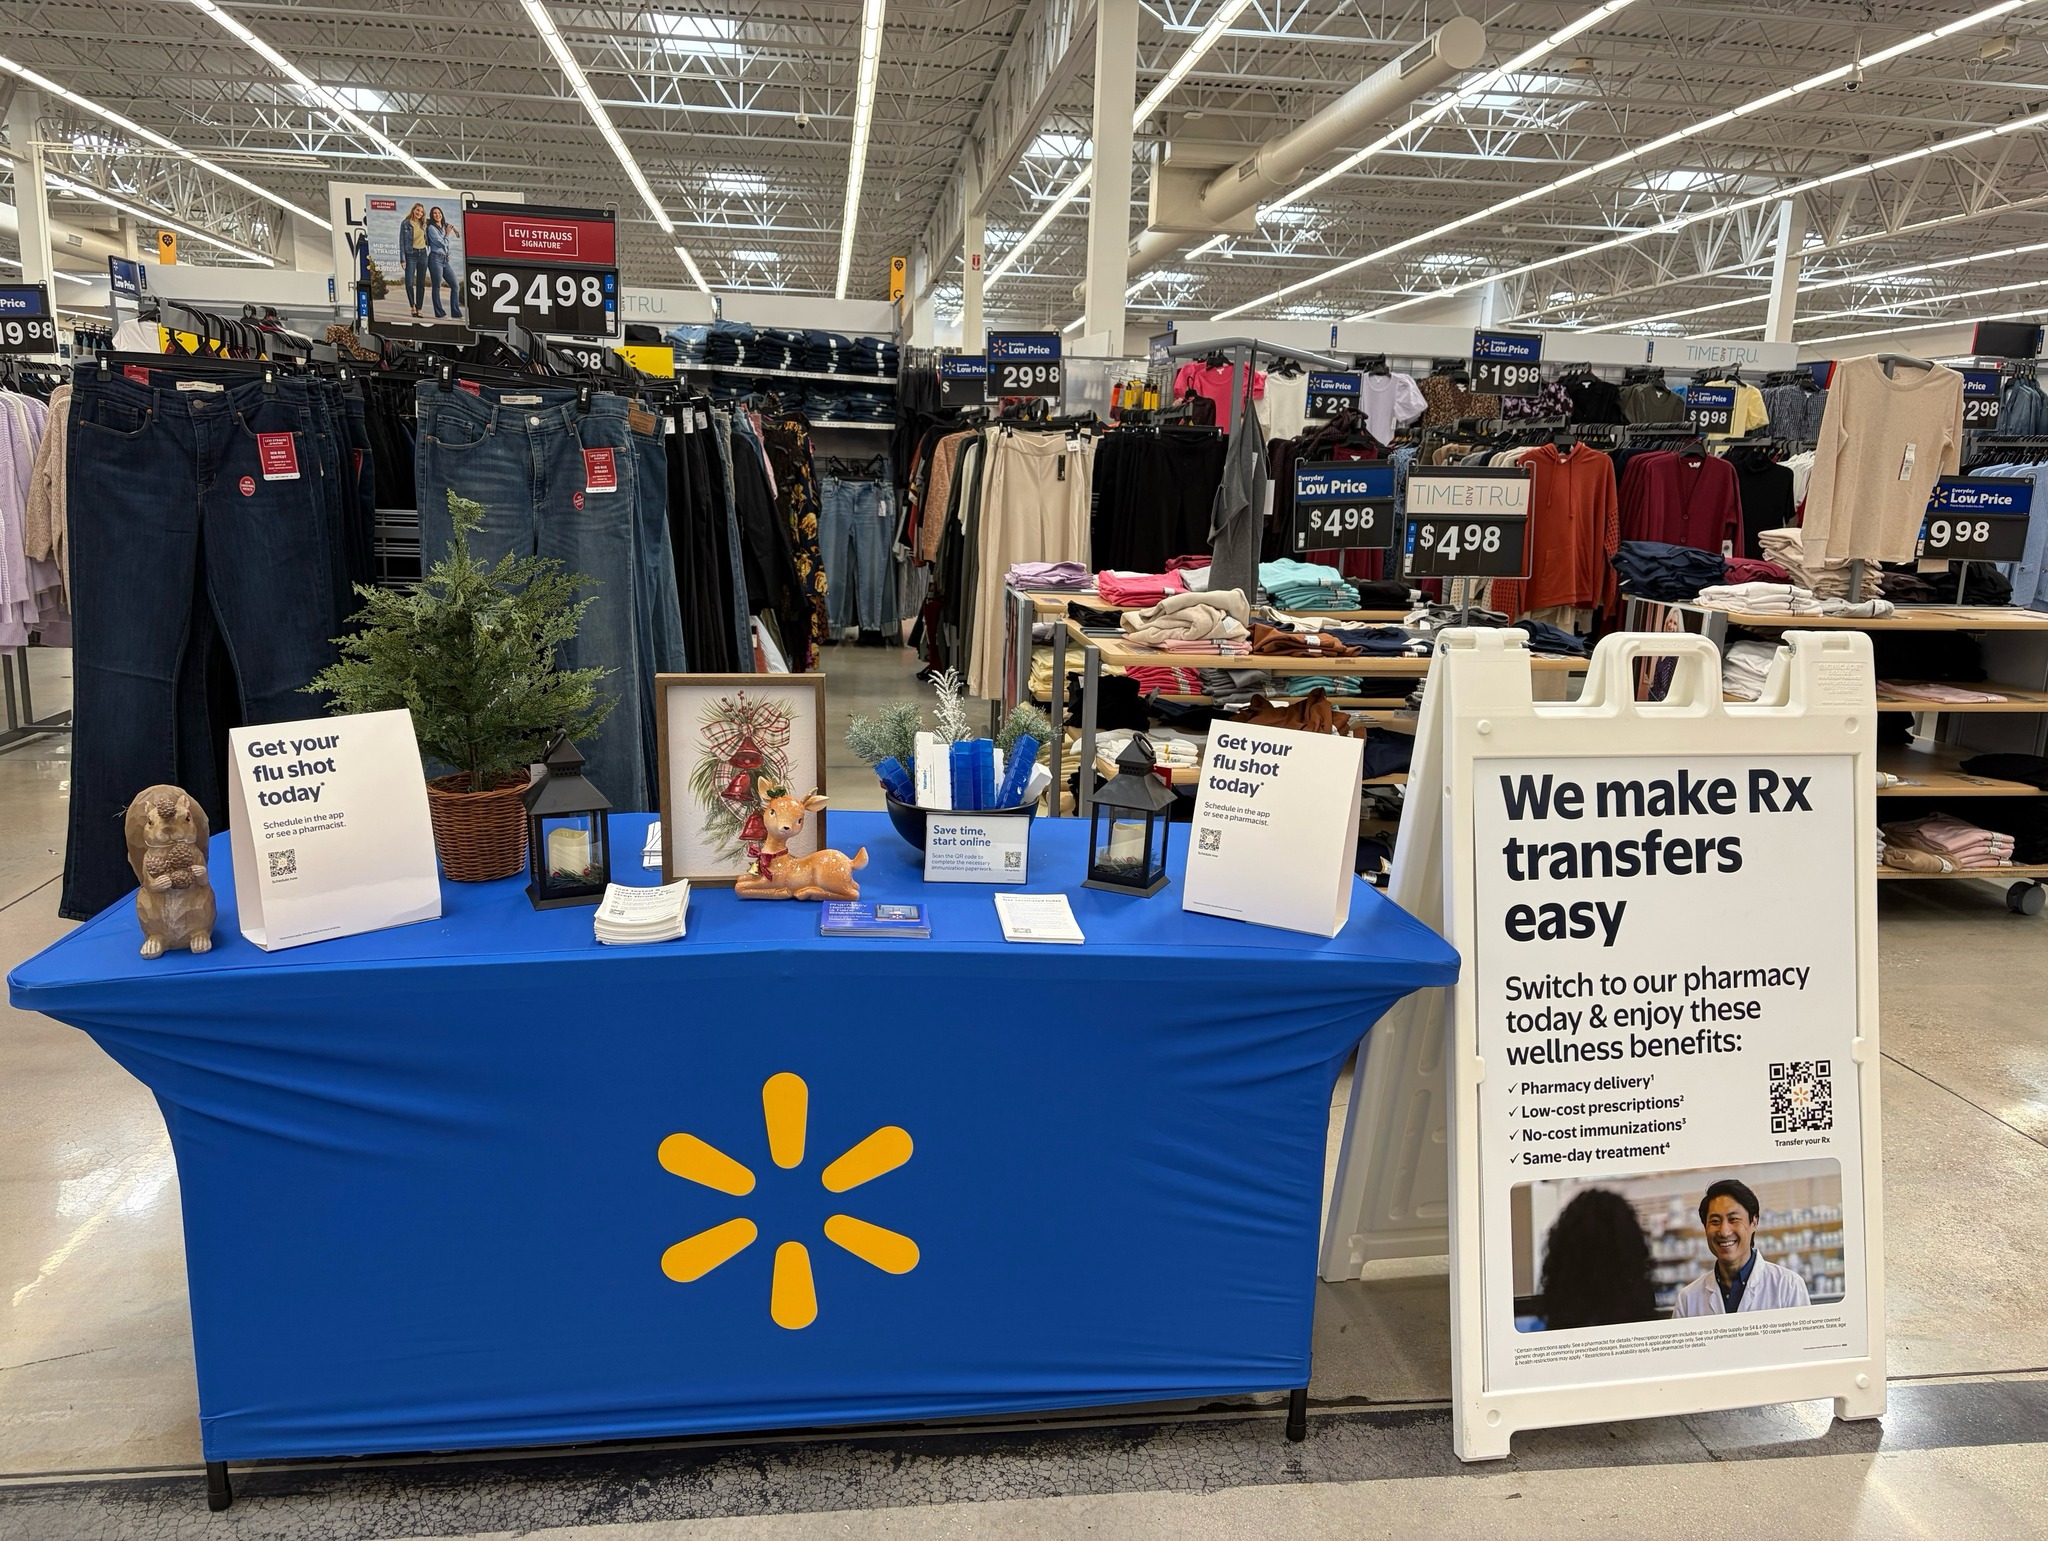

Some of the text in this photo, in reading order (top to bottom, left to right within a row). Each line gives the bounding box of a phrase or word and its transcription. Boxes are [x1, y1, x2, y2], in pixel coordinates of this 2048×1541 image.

[509, 228, 573, 242] LEVI STRAUSS
[469, 269, 603, 315] $2498
[1009, 345, 1050, 354] Low Price
[1490, 343, 1529, 354] Low Price
[1686, 346, 1720, 361] TIME
[1727, 347, 1757, 363] TRU
[957, 365, 971, 373] Low
[972, 365, 987, 373] Pric
[1003, 366, 1059, 388] 2998
[1479, 364, 1539, 387] $1998
[1335, 382, 1351, 390] Price
[1968, 382, 1986, 390] Price
[1699, 394, 1712, 402] Low
[1298, 479, 1367, 495] Low Price
[1413, 484, 1521, 507] TIME AND TRU
[1950, 492, 2012, 505] Low Price
[1310, 507, 1374, 537] $498
[1420, 523, 1501, 561] $498
[1930, 520, 1990, 548] 998
[248, 735, 339, 758] Get your
[1217, 734, 1292, 756] Get your
[253, 758, 336, 782] flu shot
[1213, 754, 1280, 777] flu shot
[1499, 768, 1813, 821] We make Rx
[1204, 802, 1236, 813] Schedule
[1245, 807, 1256, 815] the
[1257, 810, 1270, 818] app
[263, 818, 303, 829] Schedule
[314, 814, 327, 822] the
[329, 812, 344, 820] app
[299, 821, 346, 835] pharmacist.
[1229, 814, 1269, 826] pharmacist.
[933, 825, 986, 837] Save time,
[933, 837, 991, 846] start online
[1502, 829, 1743, 882] transfers
[1504, 900, 1628, 947] easy
[1506, 965, 1810, 1001] Switch to our pharmacy
[1506, 997, 1761, 1035] today & enjoy these
[1506, 1029, 1742, 1065] wellness benefits:
[1521, 1079, 1591, 1095] Pharmacy
[1522, 1103, 1585, 1119] Low-cost
[1522, 1127, 1577, 1142] No-cost
[1775, 1138, 1803, 1147] Transfer
[1523, 1149, 1592, 1165] Same-day
